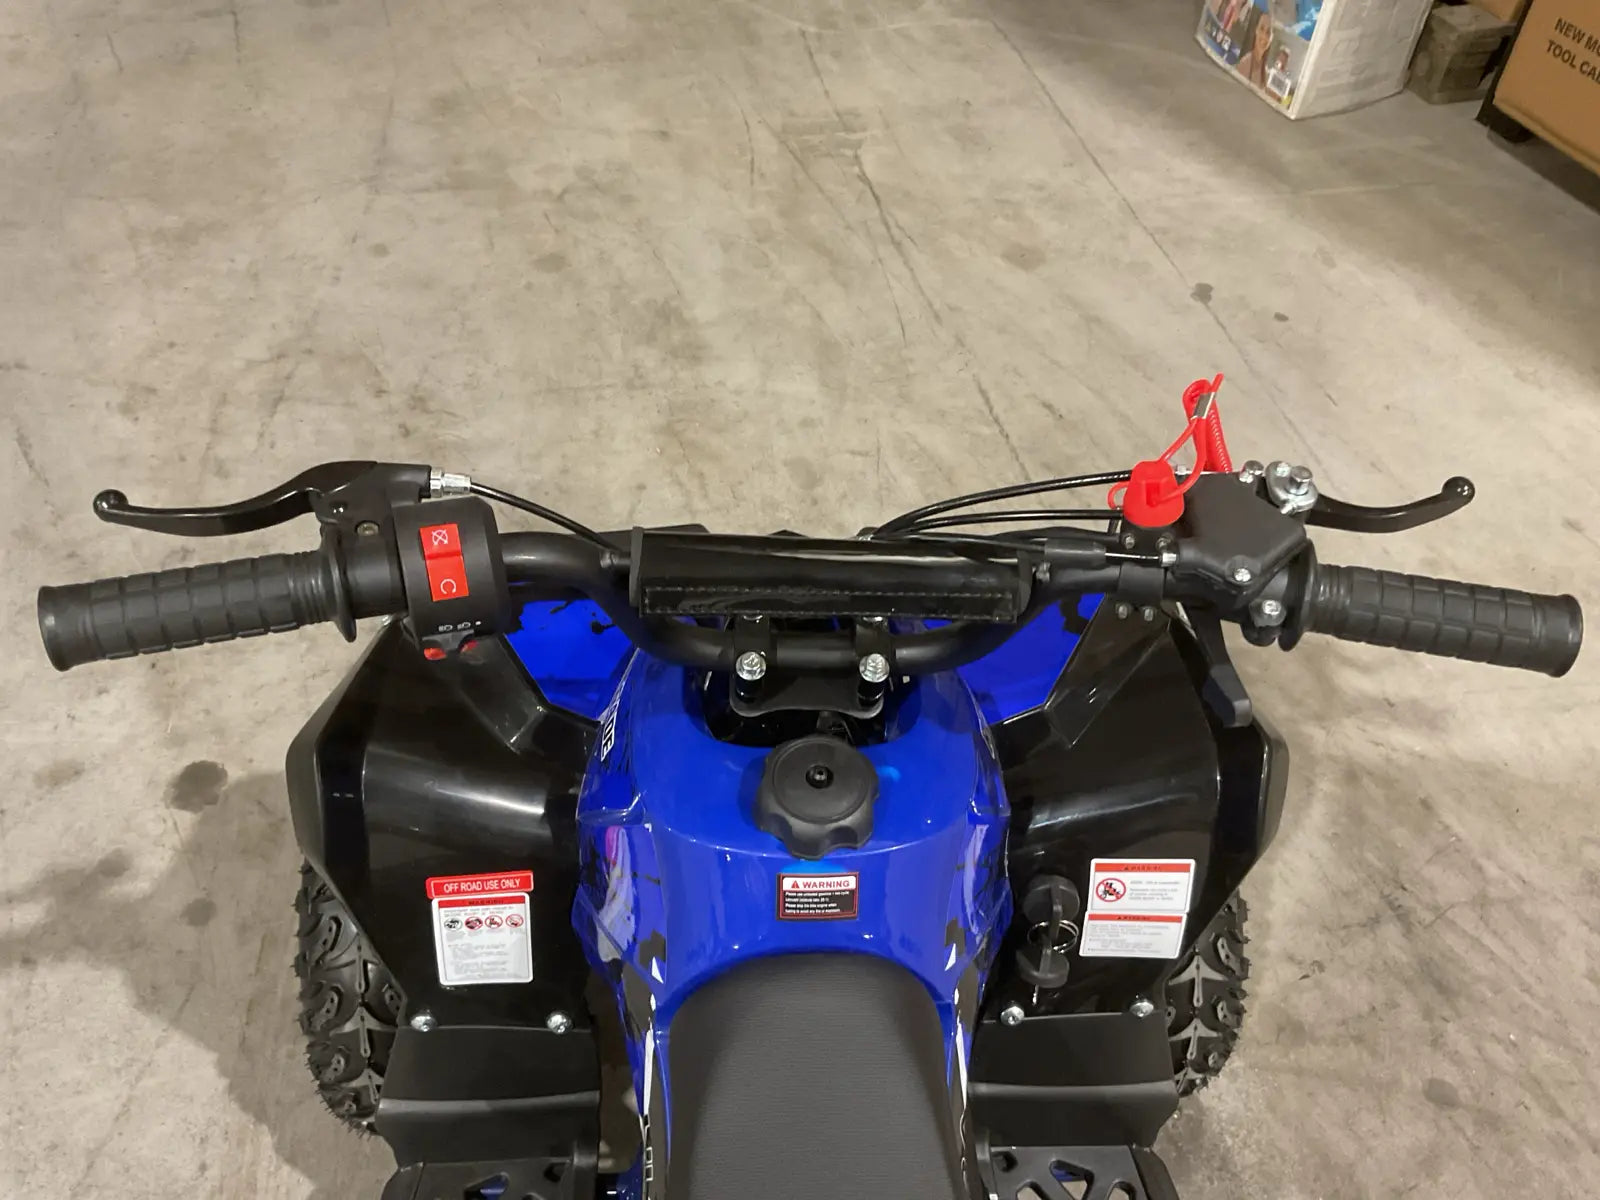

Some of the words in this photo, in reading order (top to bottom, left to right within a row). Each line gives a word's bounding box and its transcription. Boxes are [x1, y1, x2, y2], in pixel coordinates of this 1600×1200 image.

[1555, 18, 1585, 44] NEW
[1547, 39, 1576, 69] TOOL
[443, 882, 459, 893] OFF
[460, 881, 482, 892] ROAD
[484, 879, 500, 890] USE
[500, 878, 521, 889] ONLY
[802, 880, 850, 889] WARNING
